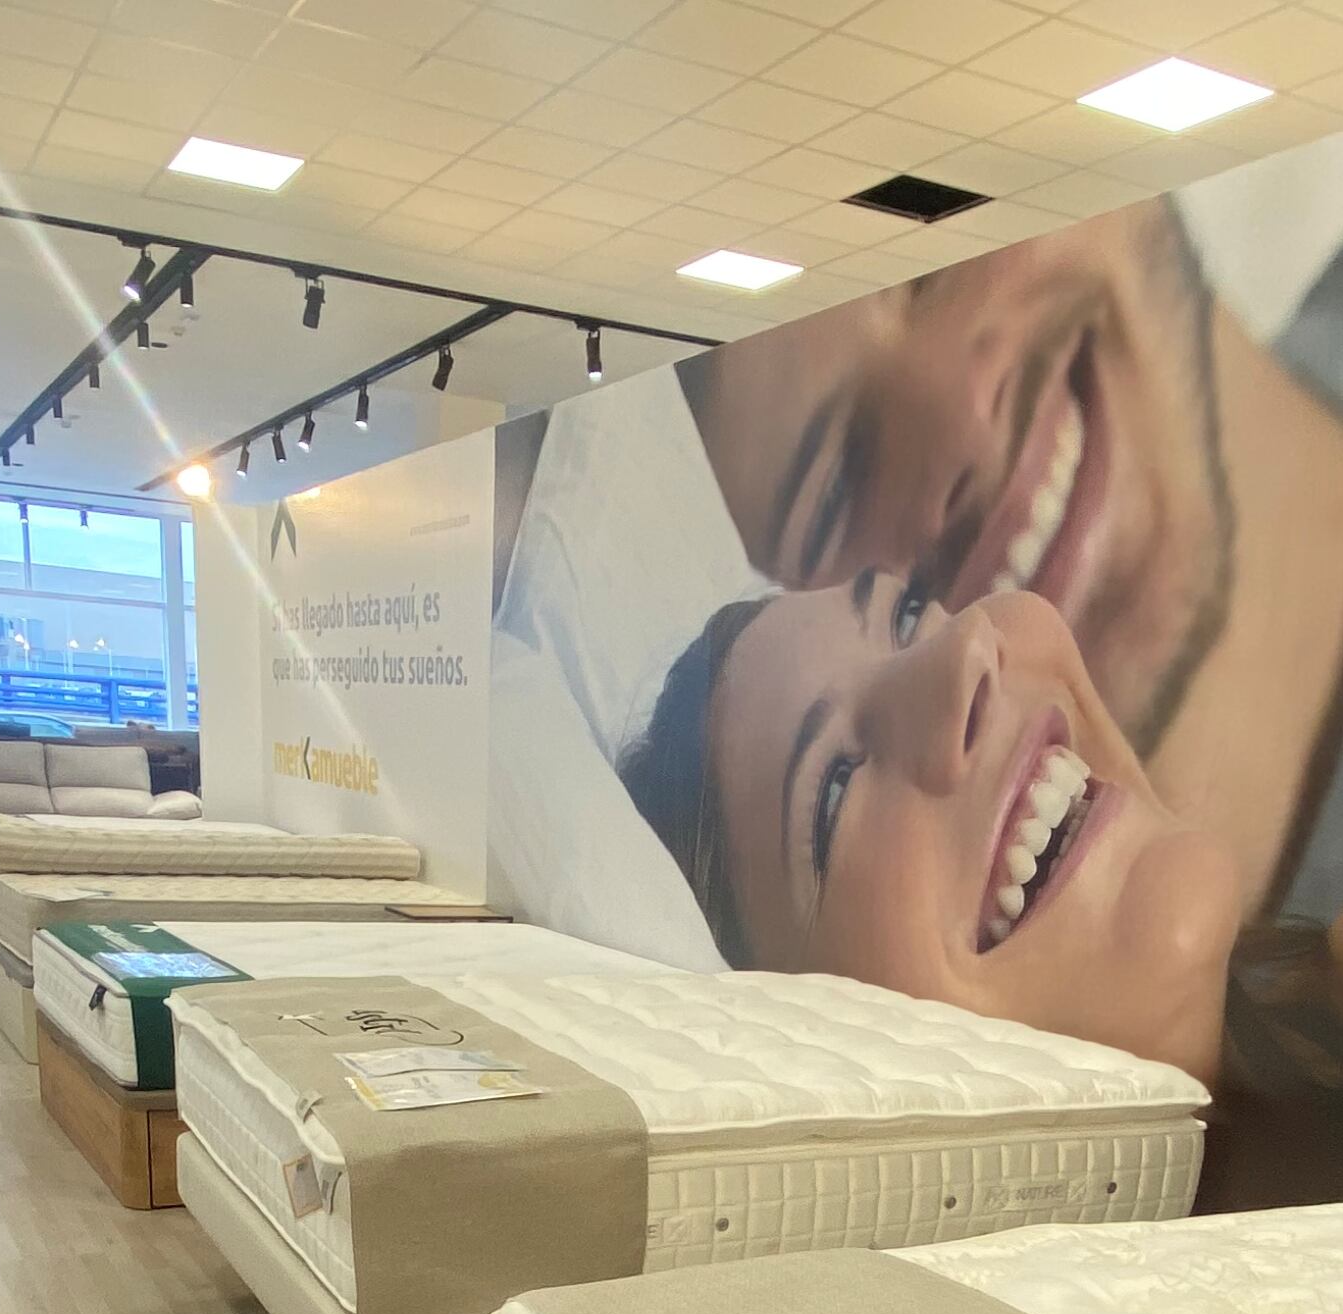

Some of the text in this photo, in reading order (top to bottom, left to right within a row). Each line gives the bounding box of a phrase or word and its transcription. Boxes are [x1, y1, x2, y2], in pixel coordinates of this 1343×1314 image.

[302, 594, 343, 637] llegado
[345, 592, 381, 627] hasta
[384, 582, 419, 632] aquí,
[423, 592, 440, 622] es
[272, 645, 468, 690] que has perseguido tus sueños.
